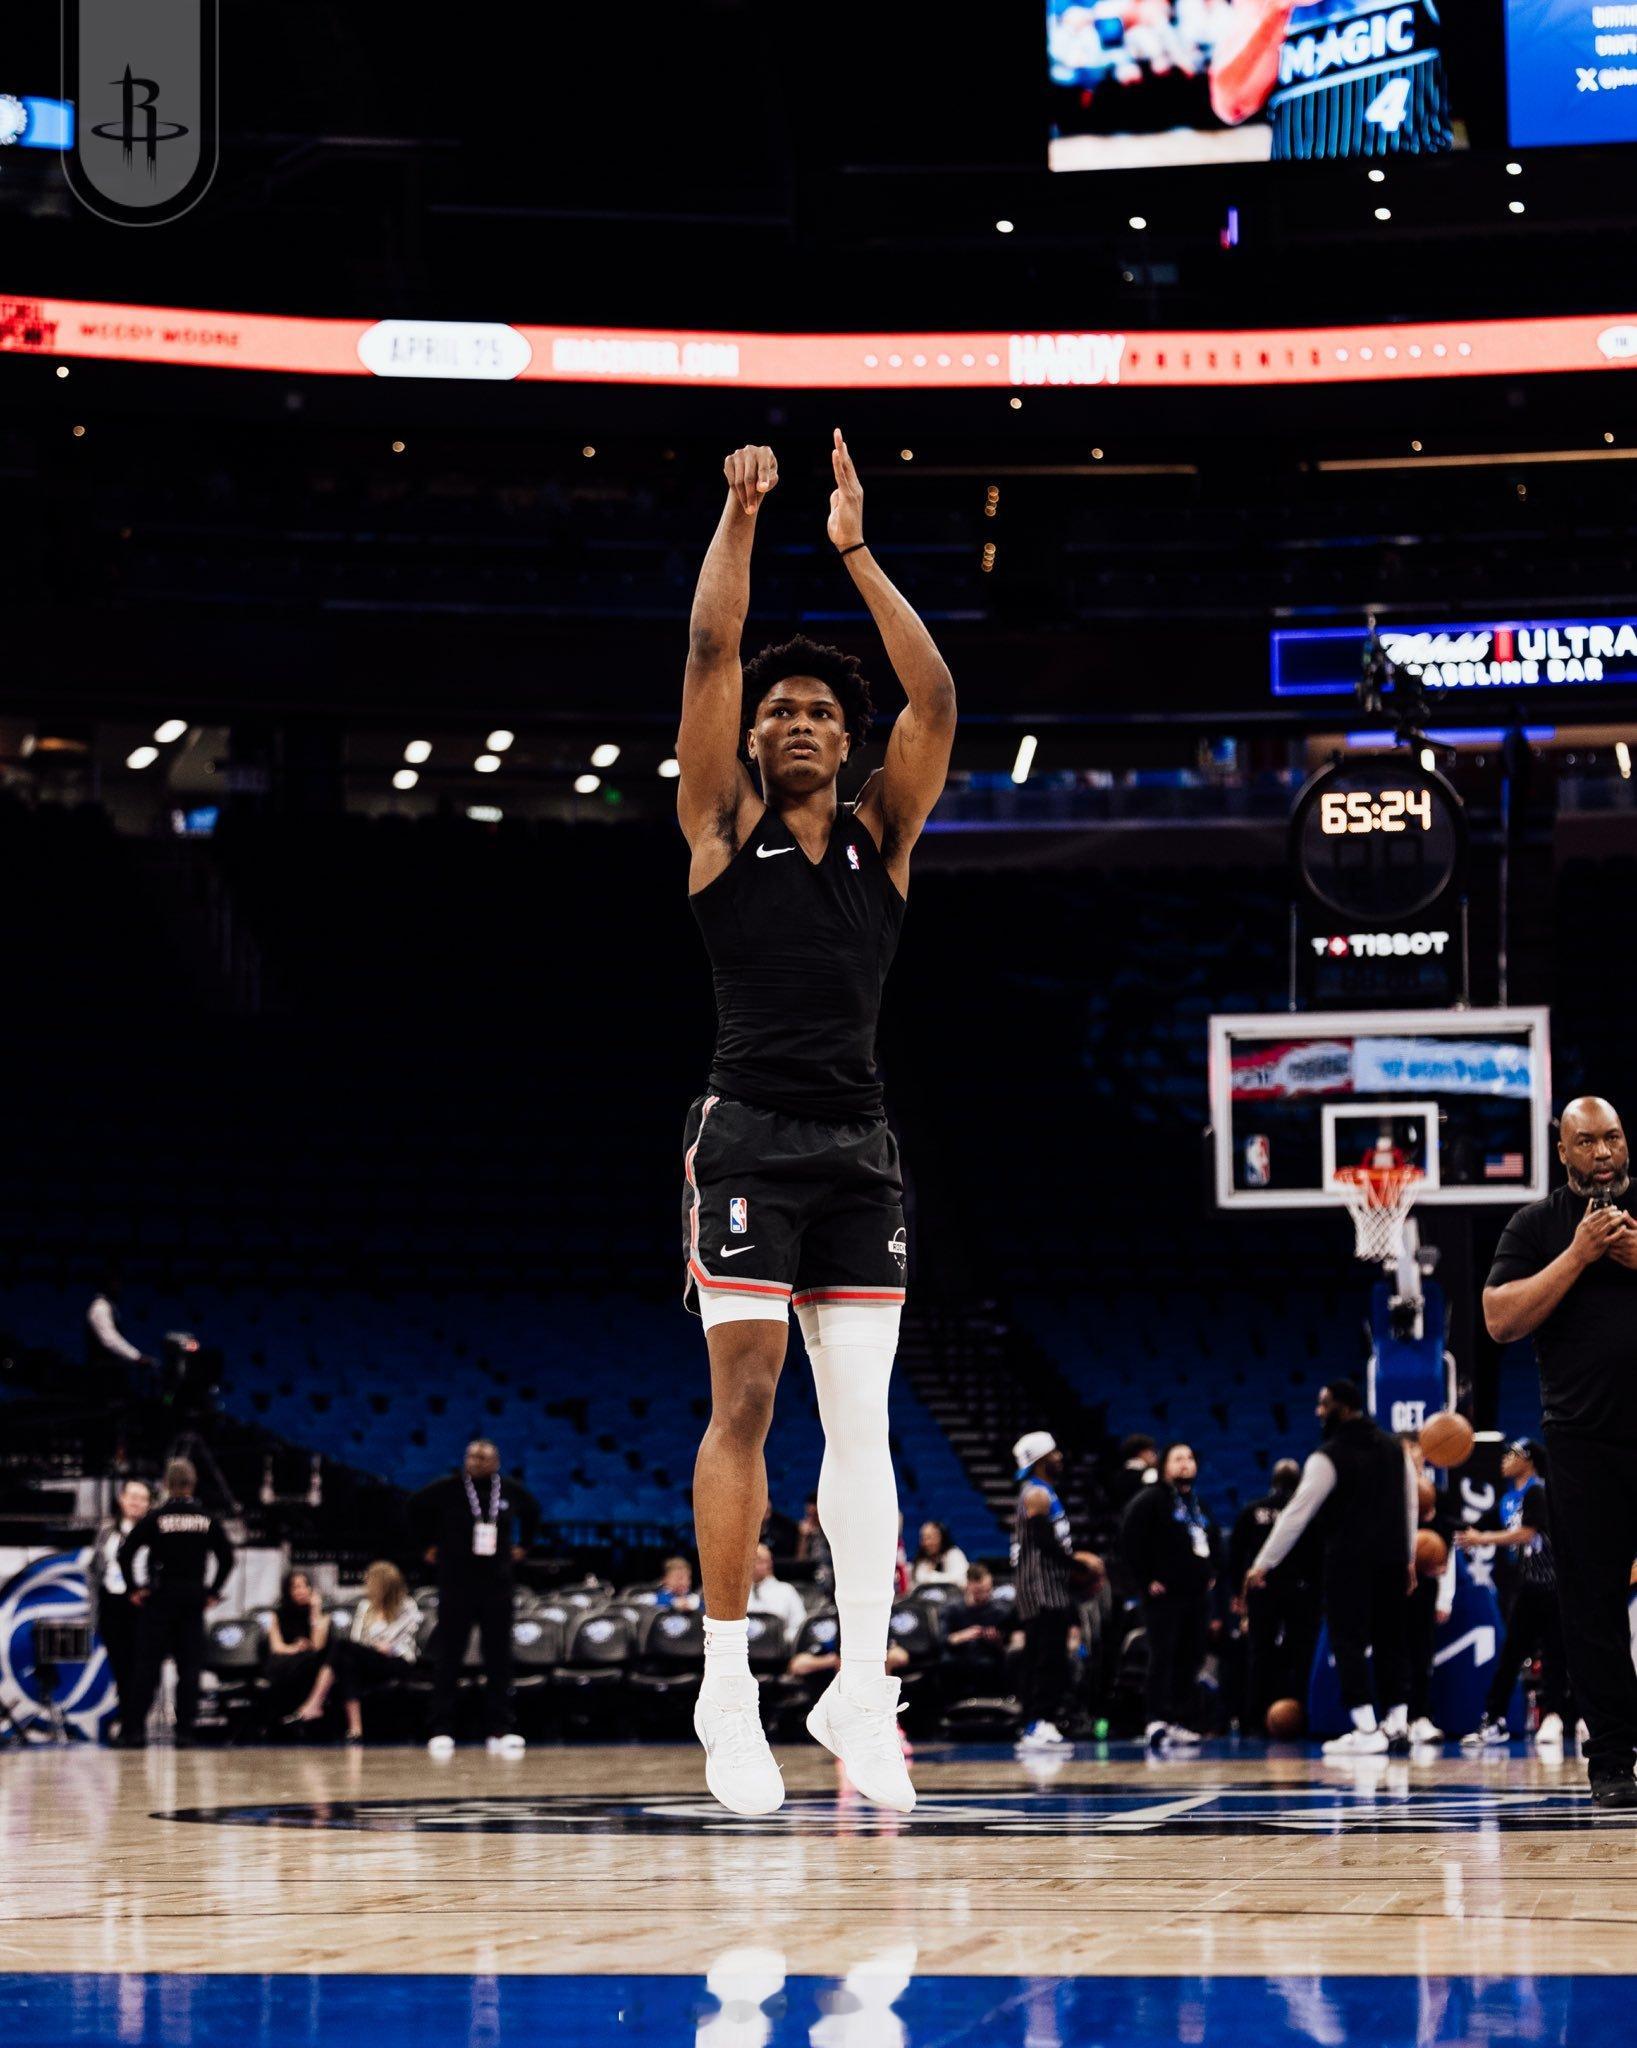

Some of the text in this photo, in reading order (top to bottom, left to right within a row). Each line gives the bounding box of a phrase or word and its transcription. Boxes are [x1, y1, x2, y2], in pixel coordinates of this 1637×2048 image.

[1365, 77, 1411, 132] 4
[1517, 625, 1637, 660] ULTRA
[1321, 790, 1432, 834] 65:24
[1349, 931, 1449, 957] TISSOT
